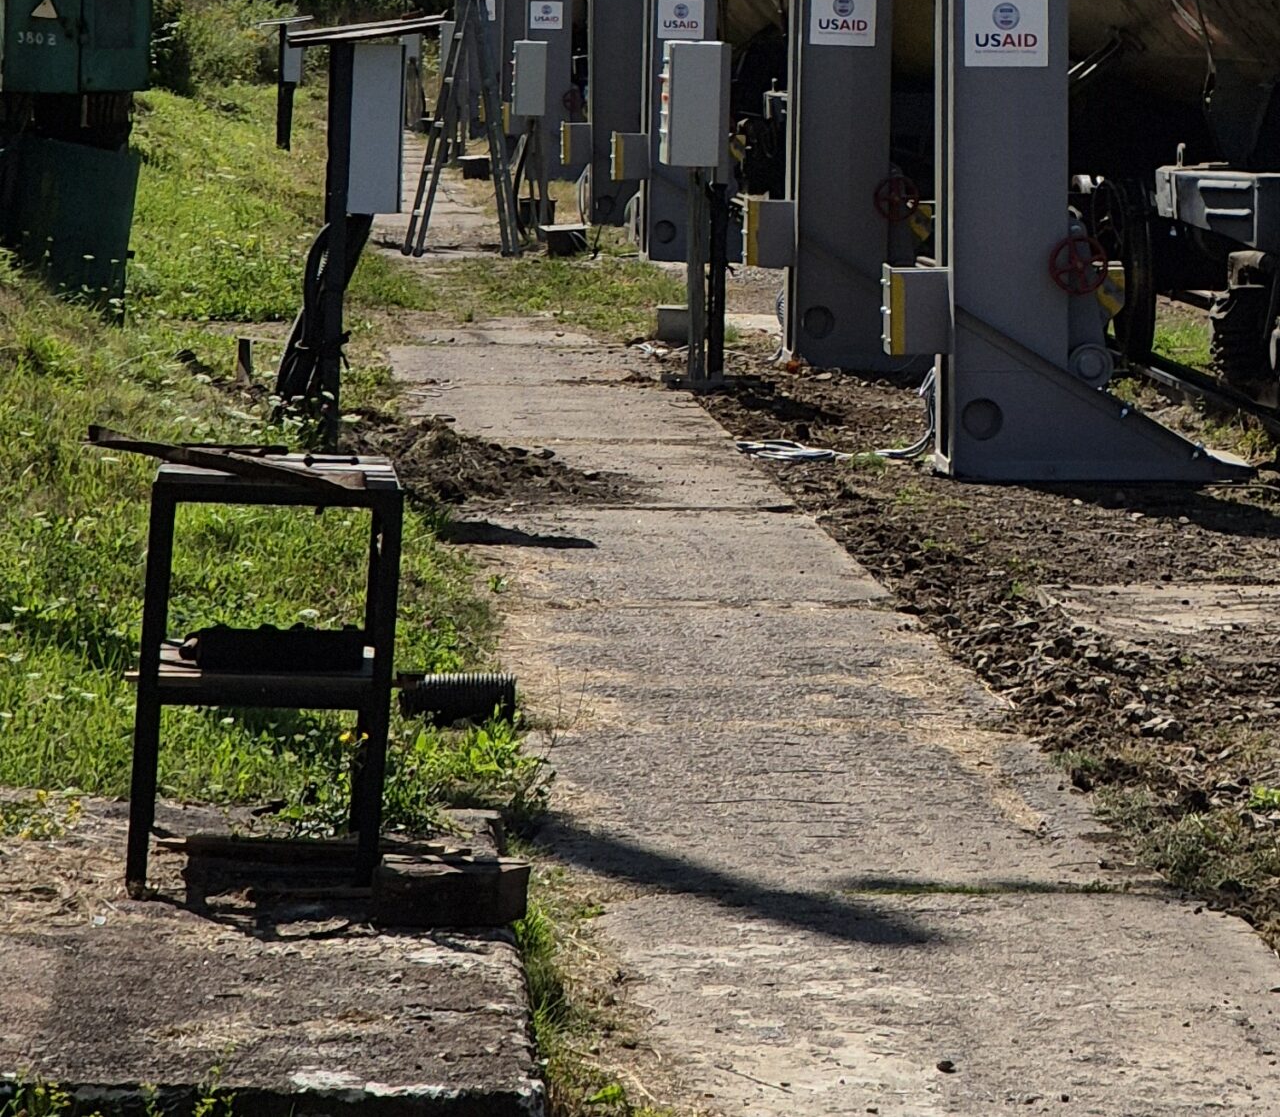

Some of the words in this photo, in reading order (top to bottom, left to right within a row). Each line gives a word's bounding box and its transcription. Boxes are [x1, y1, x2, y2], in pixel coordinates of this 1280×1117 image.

[663, 20, 699, 29] USAID
[818, 18, 868, 31] USAID
[16, 31, 45, 45] 380
[975, 33, 1038, 48] USAID
